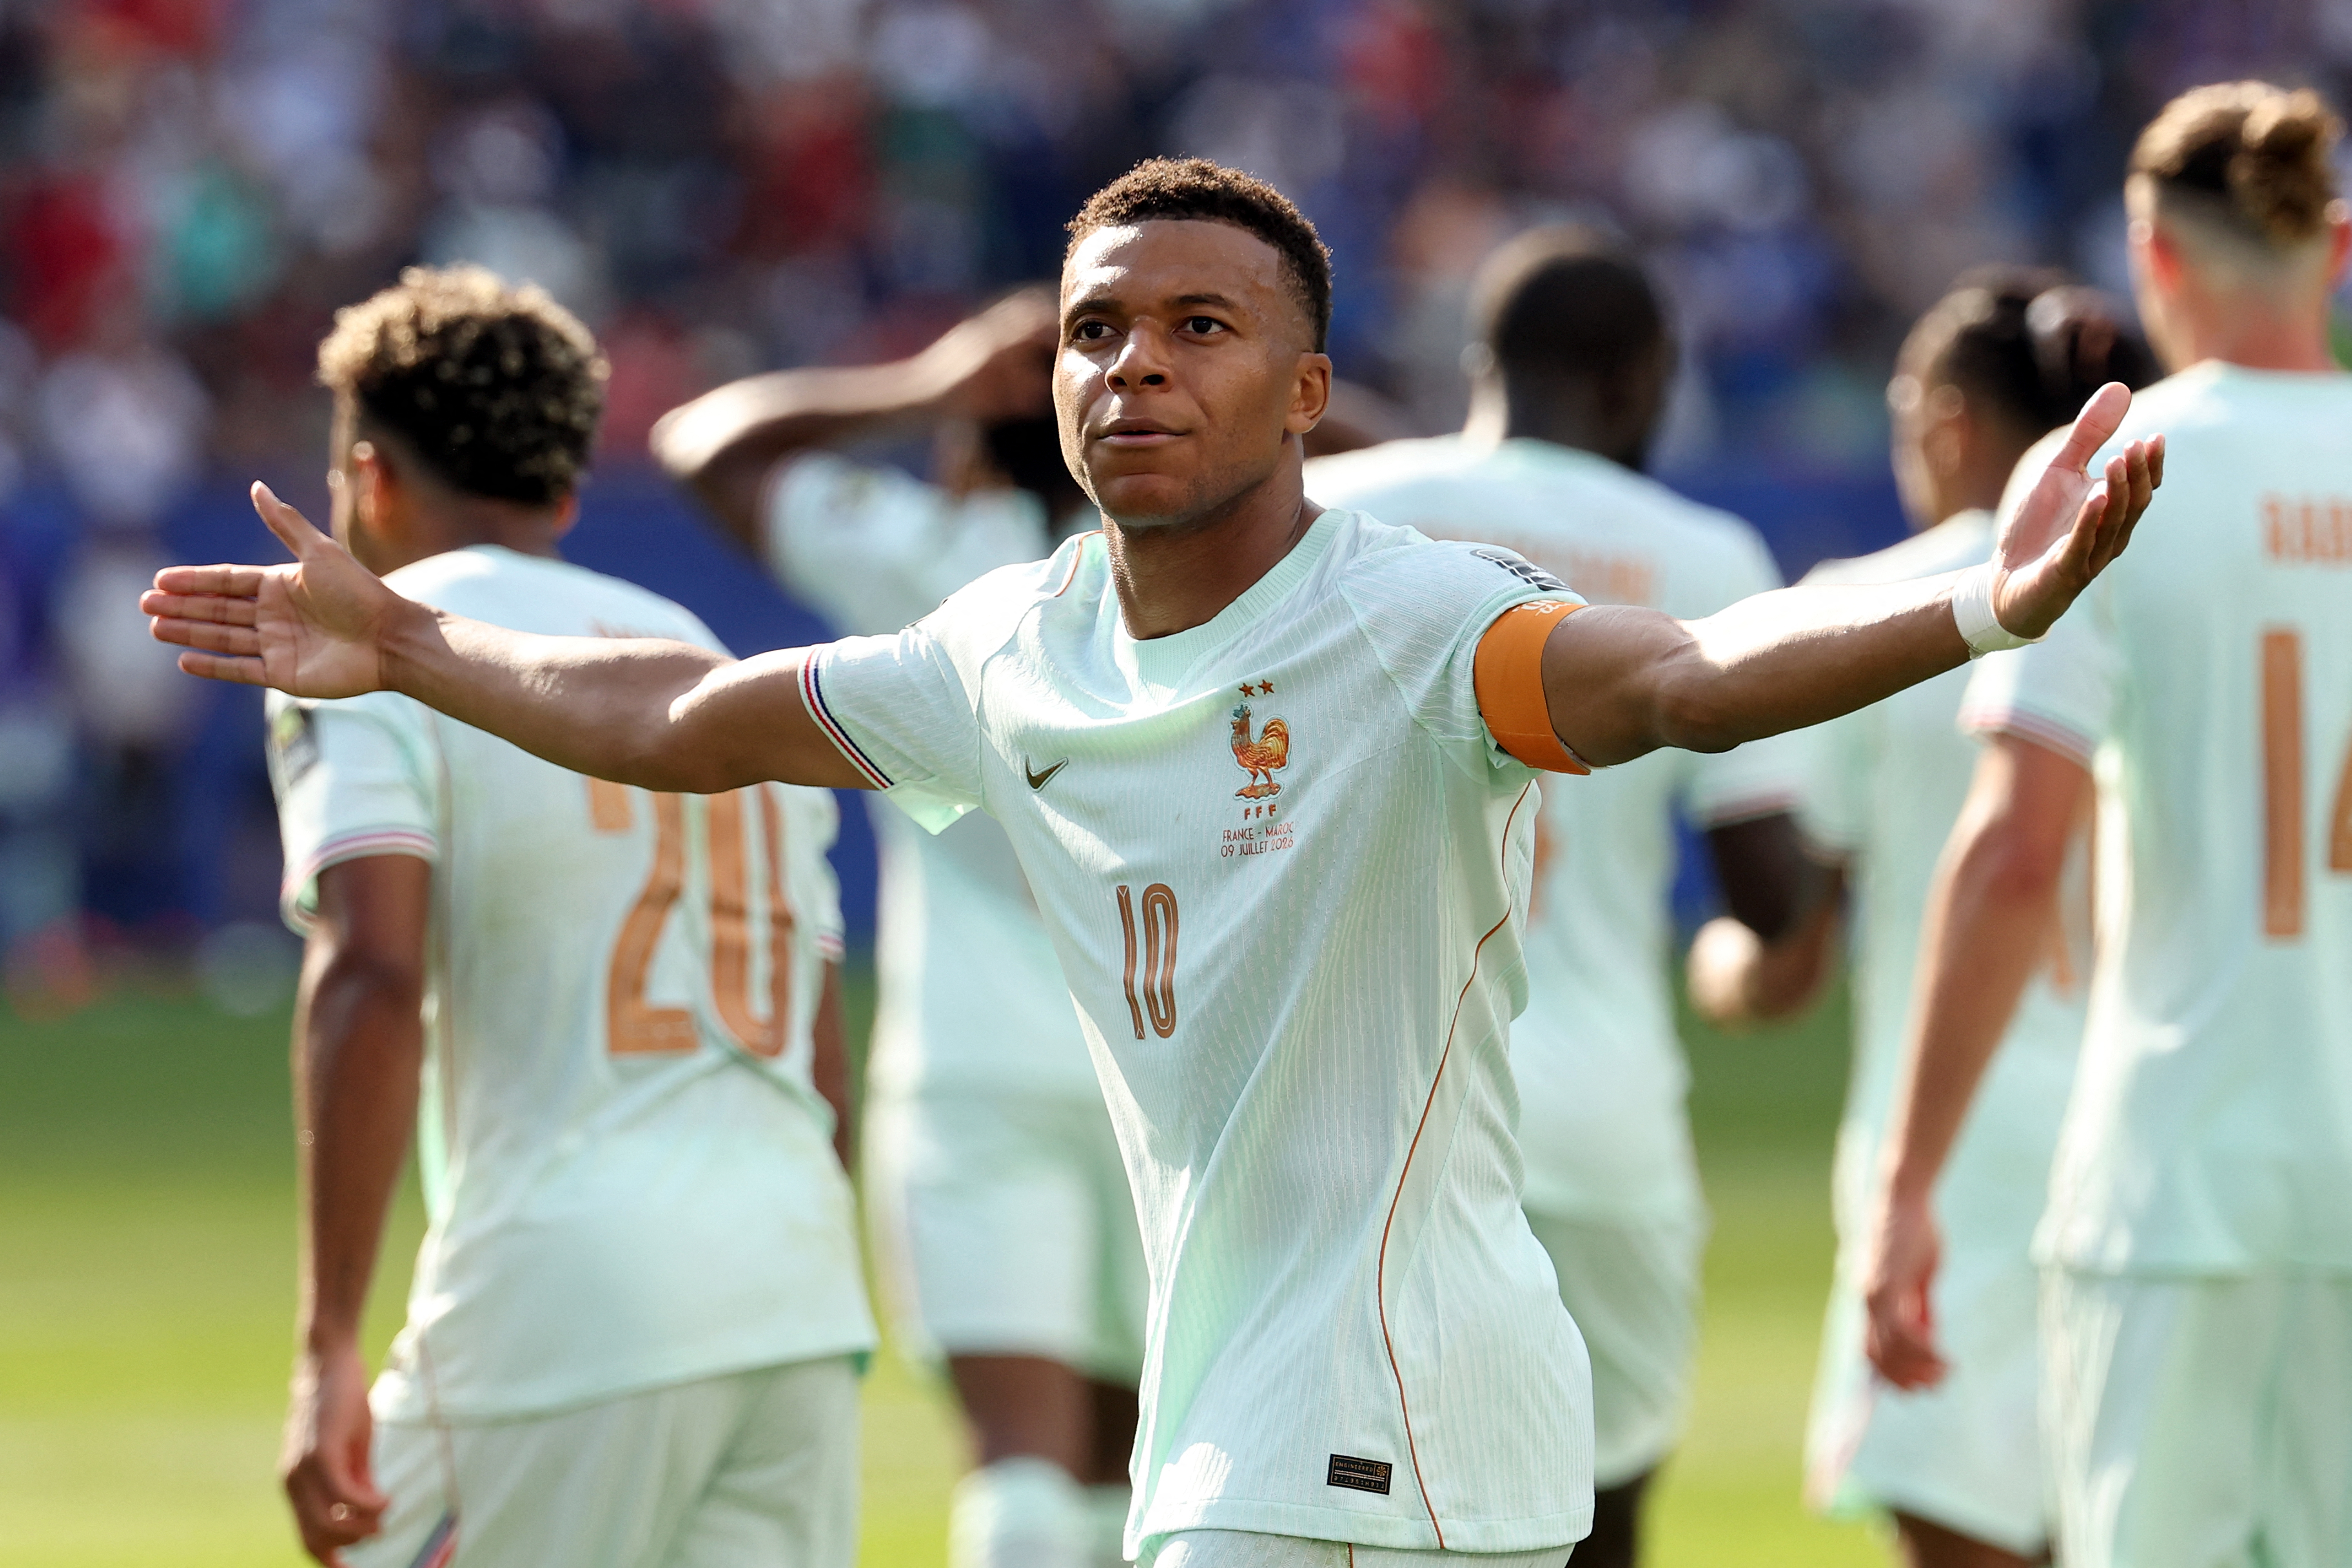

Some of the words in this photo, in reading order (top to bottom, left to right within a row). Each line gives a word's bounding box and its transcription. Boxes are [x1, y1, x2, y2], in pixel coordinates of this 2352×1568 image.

[1223, 828, 1254, 842] FRANCE
[1265, 822, 1293, 837] MAROC
[1221, 845, 1234, 857] 09
[1239, 841, 1268, 856] JUILLET
[1270, 836, 1293, 851] 2026
[586, 775, 796, 1058] 20
[1116, 883, 1179, 1039] 10
[1336, 1462, 1373, 1472] ENGINEERED
